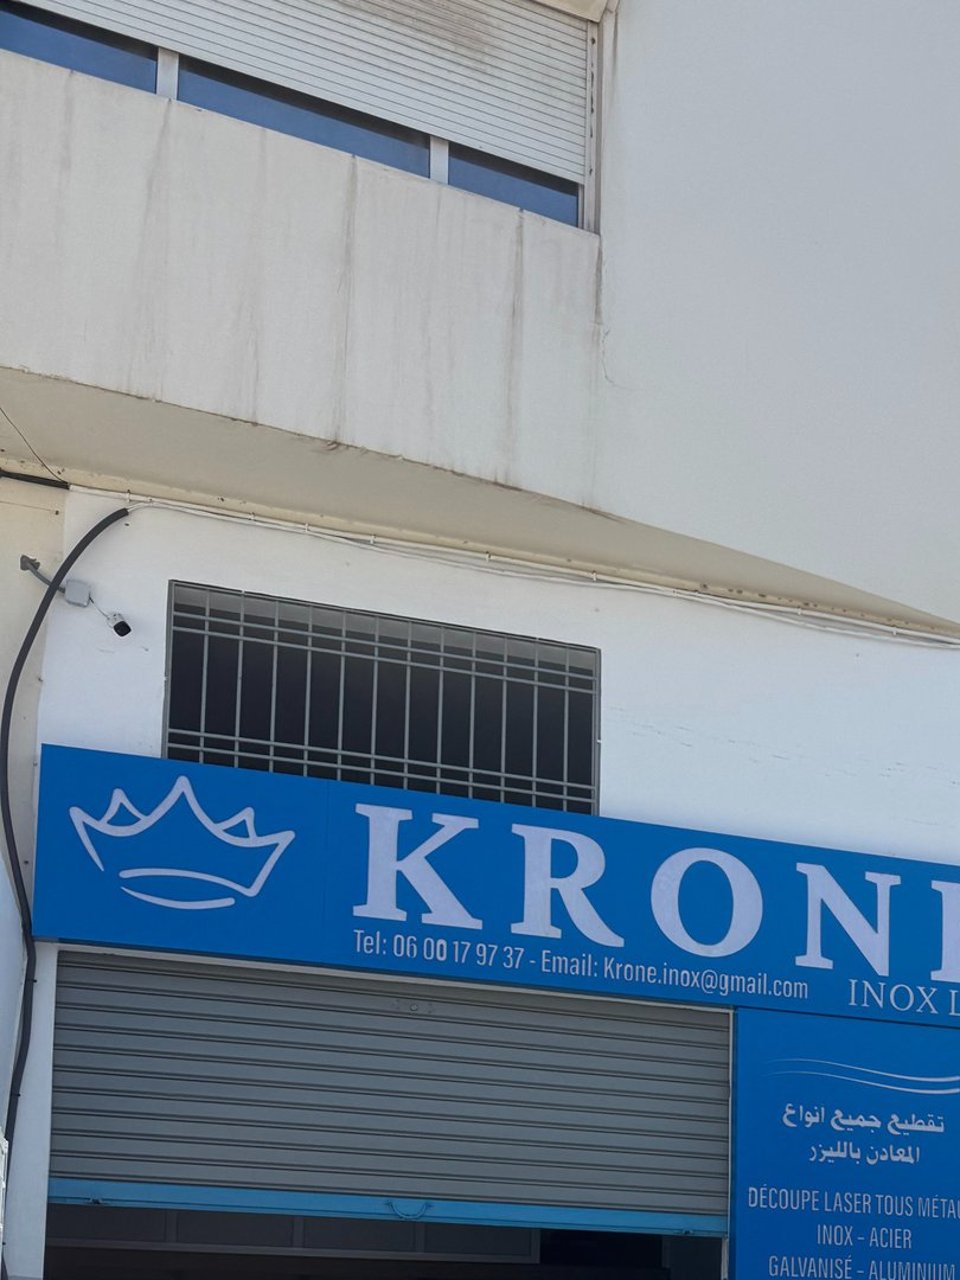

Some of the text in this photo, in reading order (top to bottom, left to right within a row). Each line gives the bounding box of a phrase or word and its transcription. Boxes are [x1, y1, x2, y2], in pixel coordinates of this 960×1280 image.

[353, 929, 387, 955] Tel:
[393, 934, 418, 959] 06
[423, 937, 448, 962] 00
[453, 940, 471, 964] 17
[476, 943, 499, 967] 97
[503, 946, 525, 970] 37
[541, 949, 599, 977] Email:
[603, 956, 809, 999] Krone.inox@gmail.com
[848, 979, 938, 1014] INOX
[830, 1108, 882, 1134] جميع
[886, 1113, 945, 1136] تقطيع
[809, 1140, 921, 1166] المعادن بالليزر
[748, 1183, 820, 1211] DÉCOUPE
[823, 1191, 872, 1215] LASER
[875, 1194, 914, 1217] TOUS
[816, 1223, 854, 1246] INOX
[869, 1227, 912, 1249] ACIER
[768, 1255, 853, 1280] GALVANISÉ
